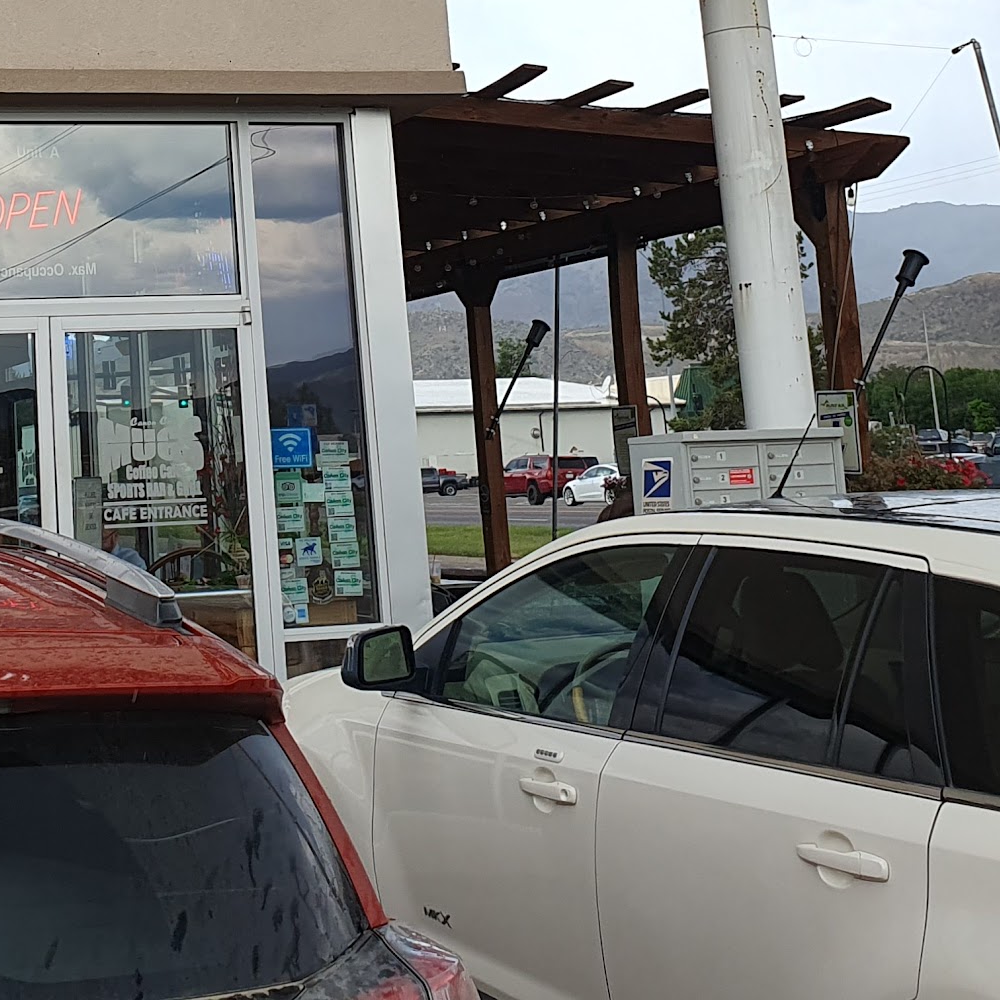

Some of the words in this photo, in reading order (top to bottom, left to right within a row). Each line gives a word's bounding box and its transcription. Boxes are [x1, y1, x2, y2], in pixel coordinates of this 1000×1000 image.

[274, 455, 291, 463] Free
[293, 454, 308, 463] WiFi
[107, 482, 145, 499] SPORTS
[103, 507, 137, 522] CAFE
[140, 504, 208, 520] ENTRANCE
